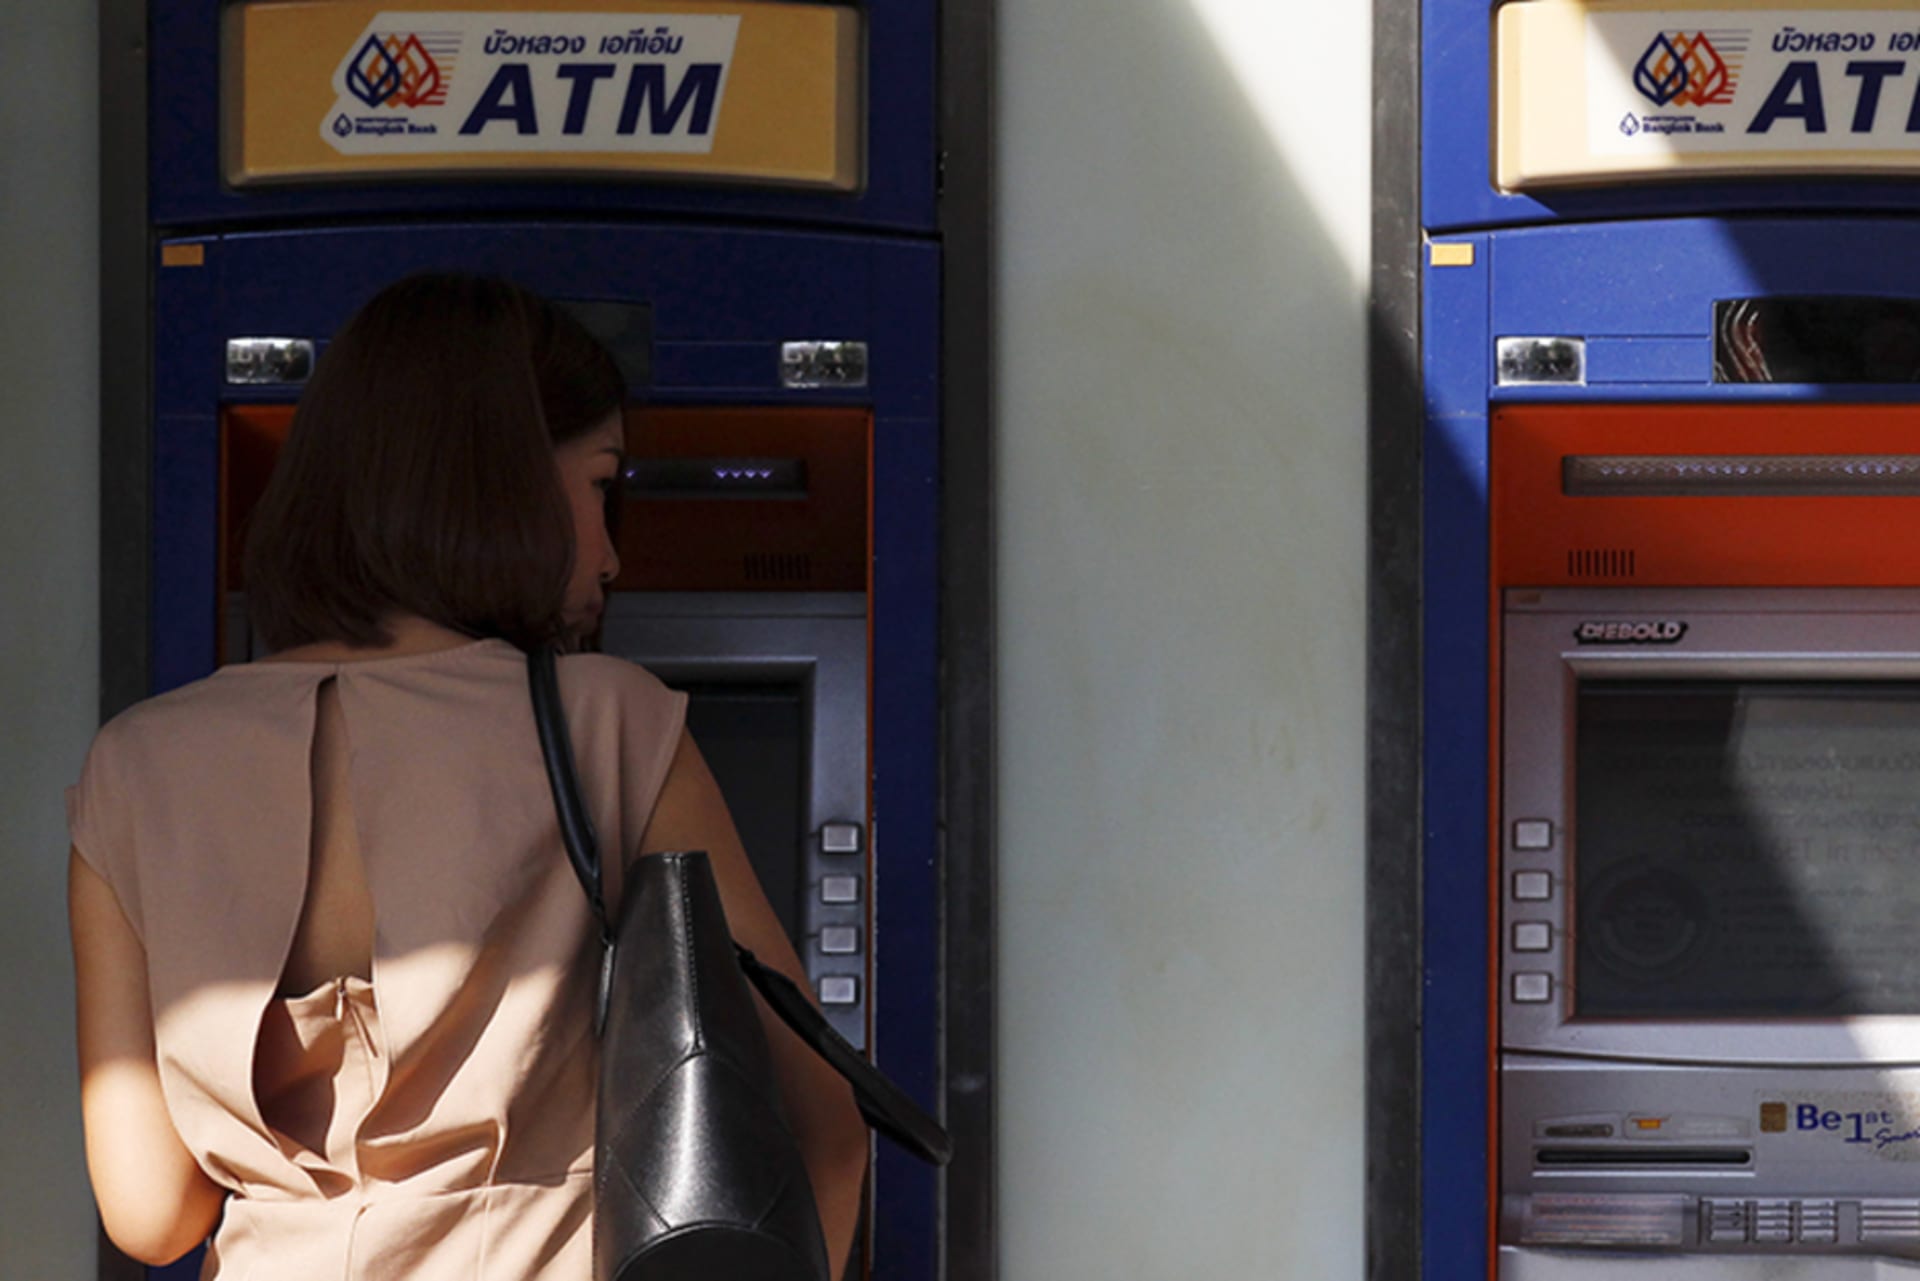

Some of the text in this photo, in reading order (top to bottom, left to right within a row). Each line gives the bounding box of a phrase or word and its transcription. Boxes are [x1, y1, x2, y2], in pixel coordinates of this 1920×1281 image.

[484, 27, 683, 54] บัวหลวง เอทีเอ็ม
[1771, 26, 1876, 52] บัวหลวง
[458, 63, 723, 135] ATM
[1745, 61, 1920, 133] AT
[1581, 622, 1681, 640] DIEBOLD
